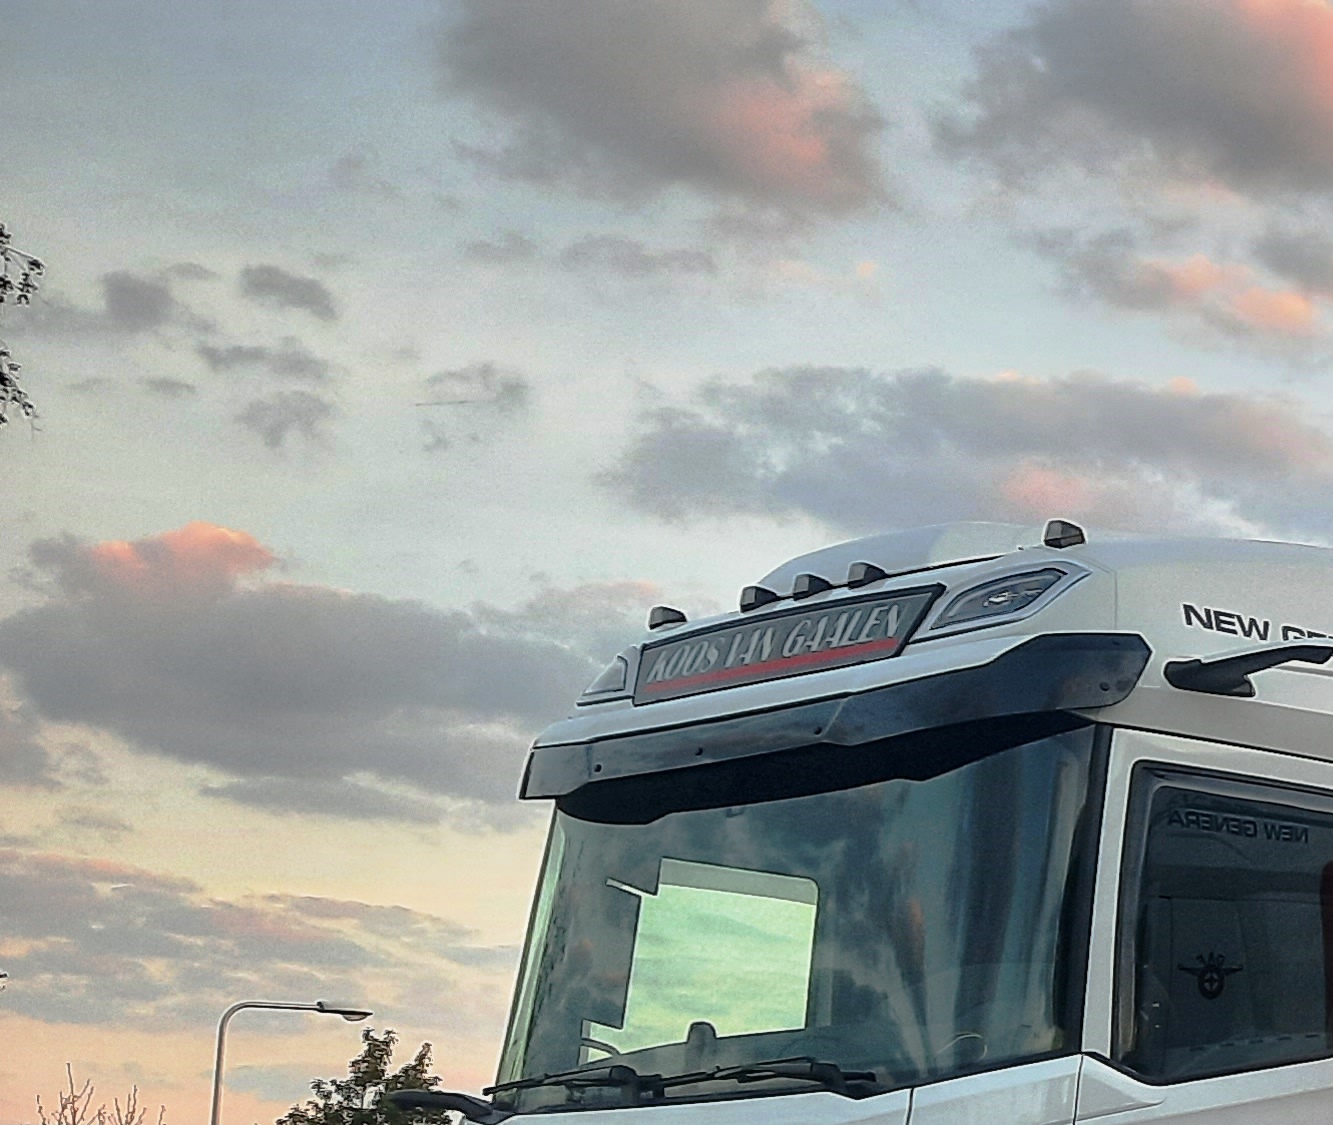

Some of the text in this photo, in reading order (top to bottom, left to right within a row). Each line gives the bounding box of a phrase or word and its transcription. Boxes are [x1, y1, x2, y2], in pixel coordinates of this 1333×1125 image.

[646, 638, 720, 684] KOOS
[781, 603, 908, 659] GAALEN
[1182, 603, 1270, 642] NEW
